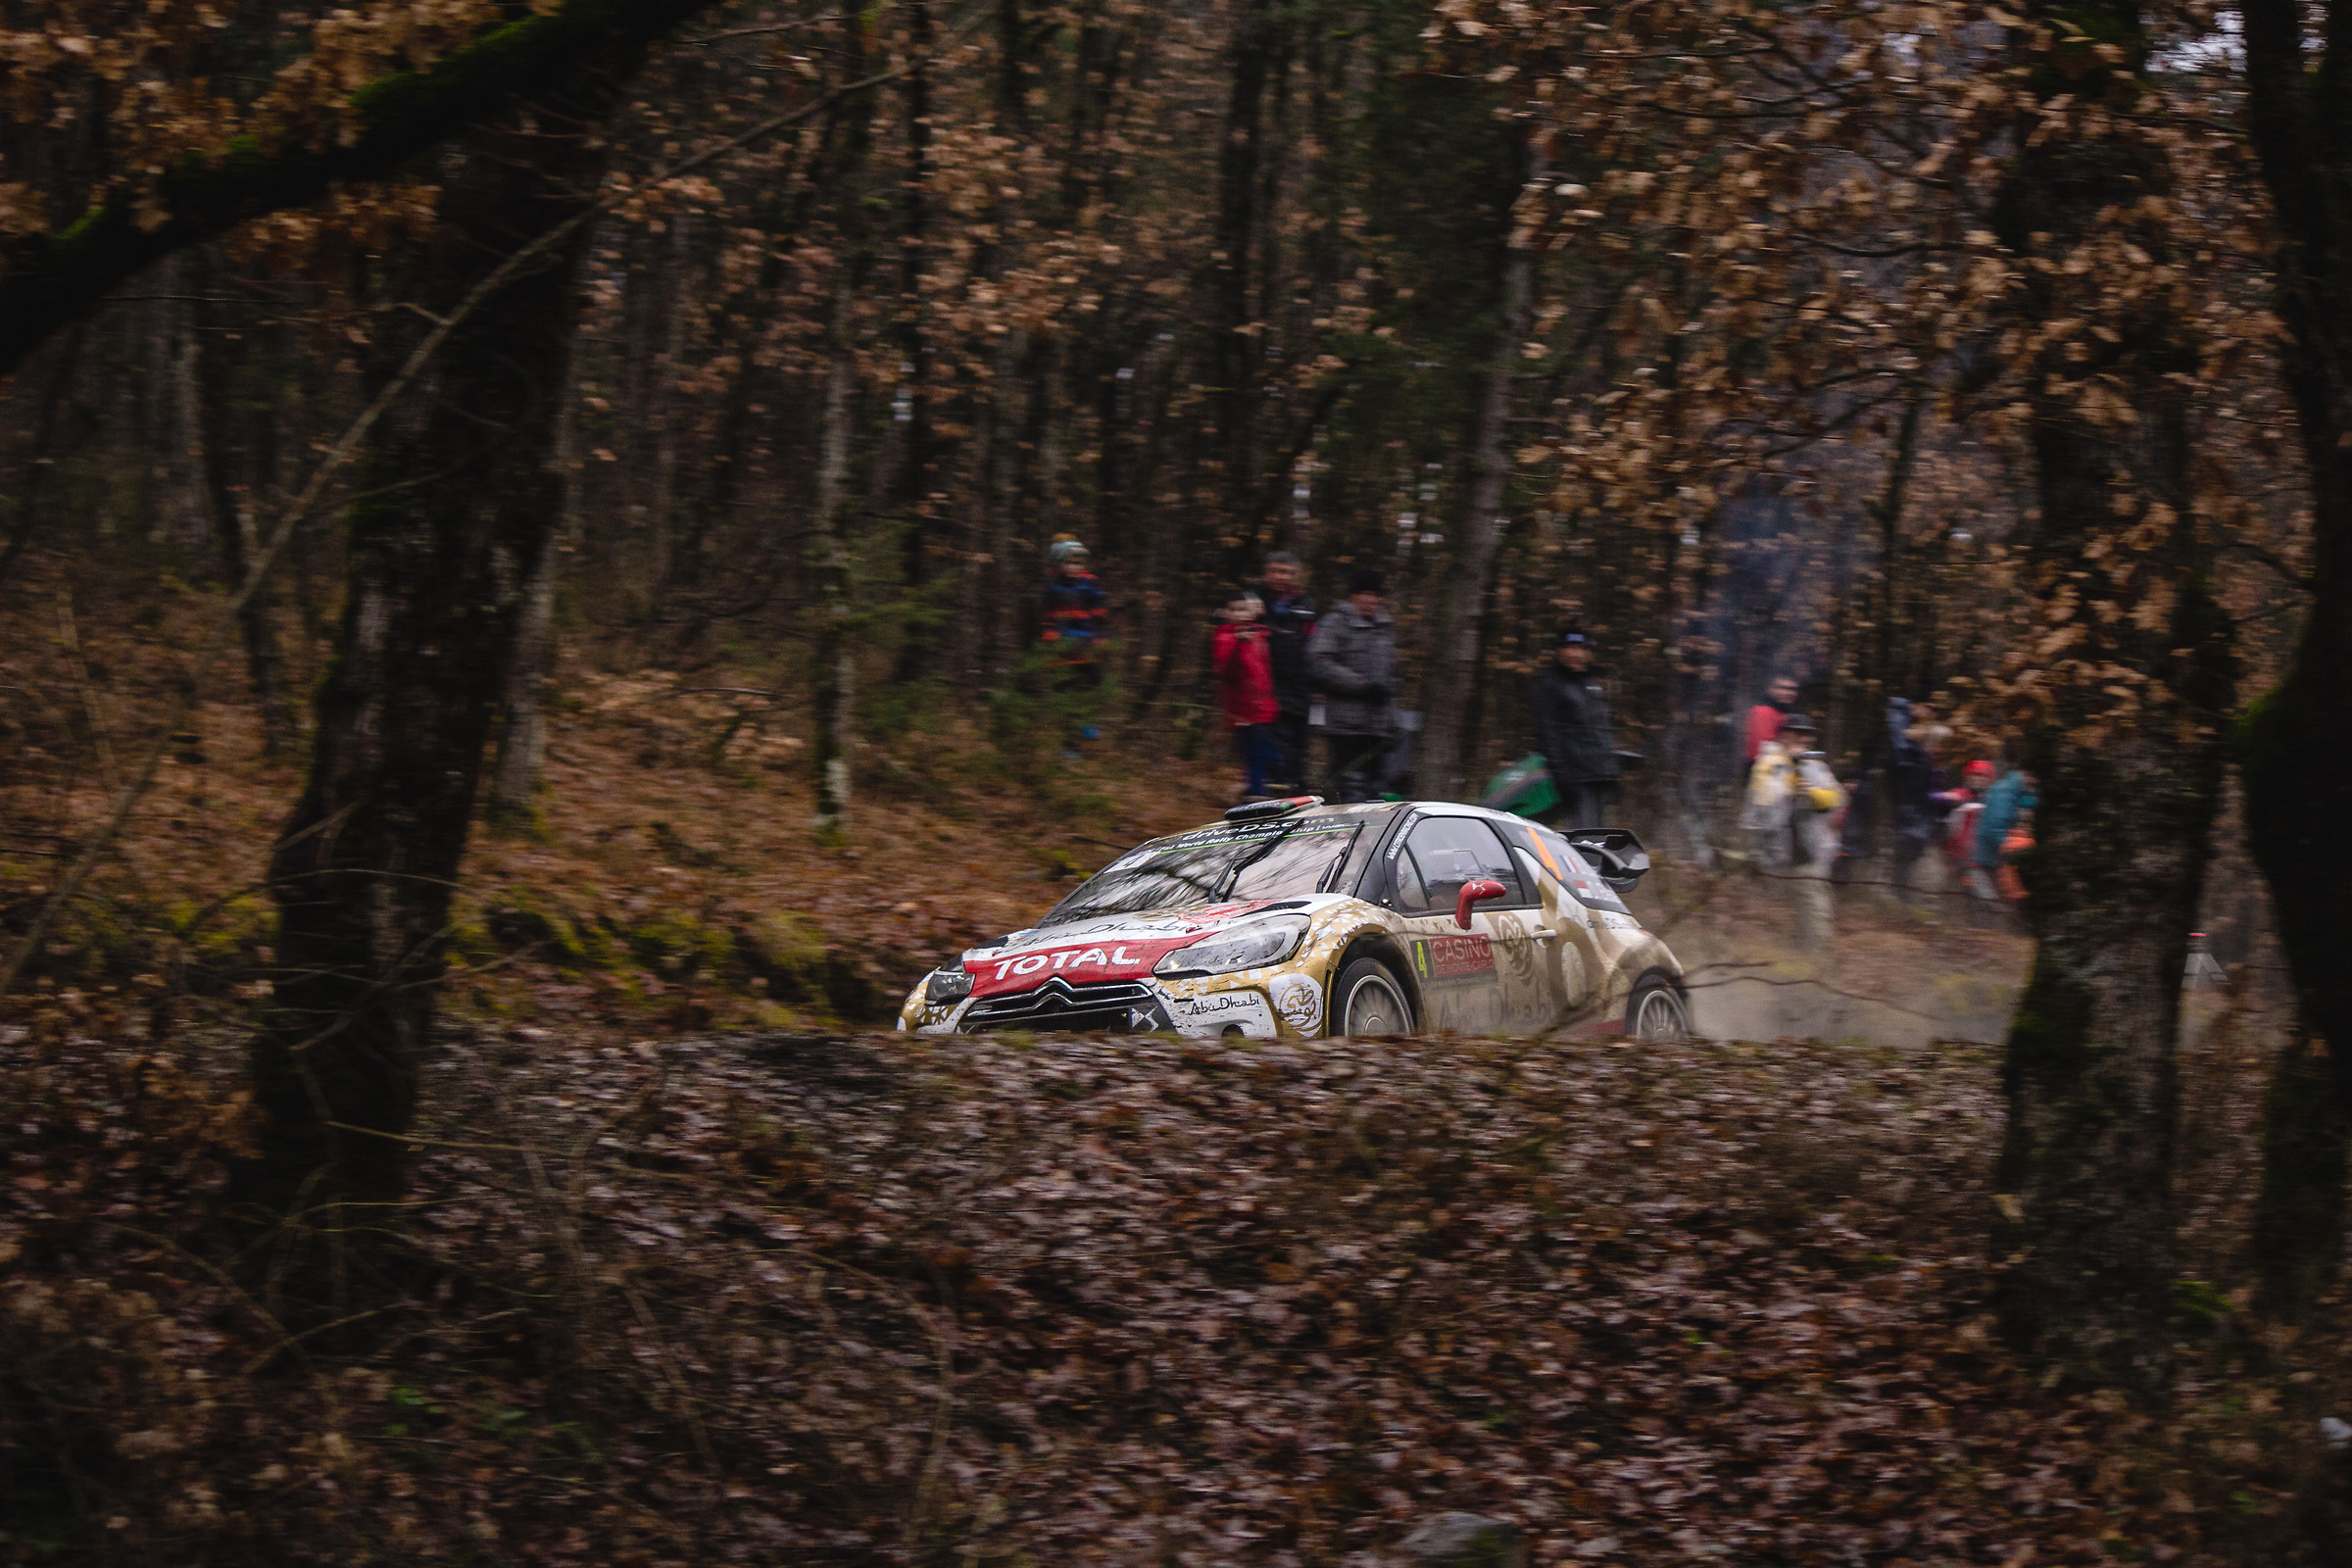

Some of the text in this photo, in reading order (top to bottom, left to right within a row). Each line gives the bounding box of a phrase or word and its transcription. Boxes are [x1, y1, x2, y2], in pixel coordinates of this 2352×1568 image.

[1206, 836, 1234, 845] Rally
[1417, 941, 1428, 978] 4
[1432, 936, 1493, 962] CASINO
[994, 946, 1141, 980] TOTAL
[1219, 993, 1260, 1010] Dhabi
